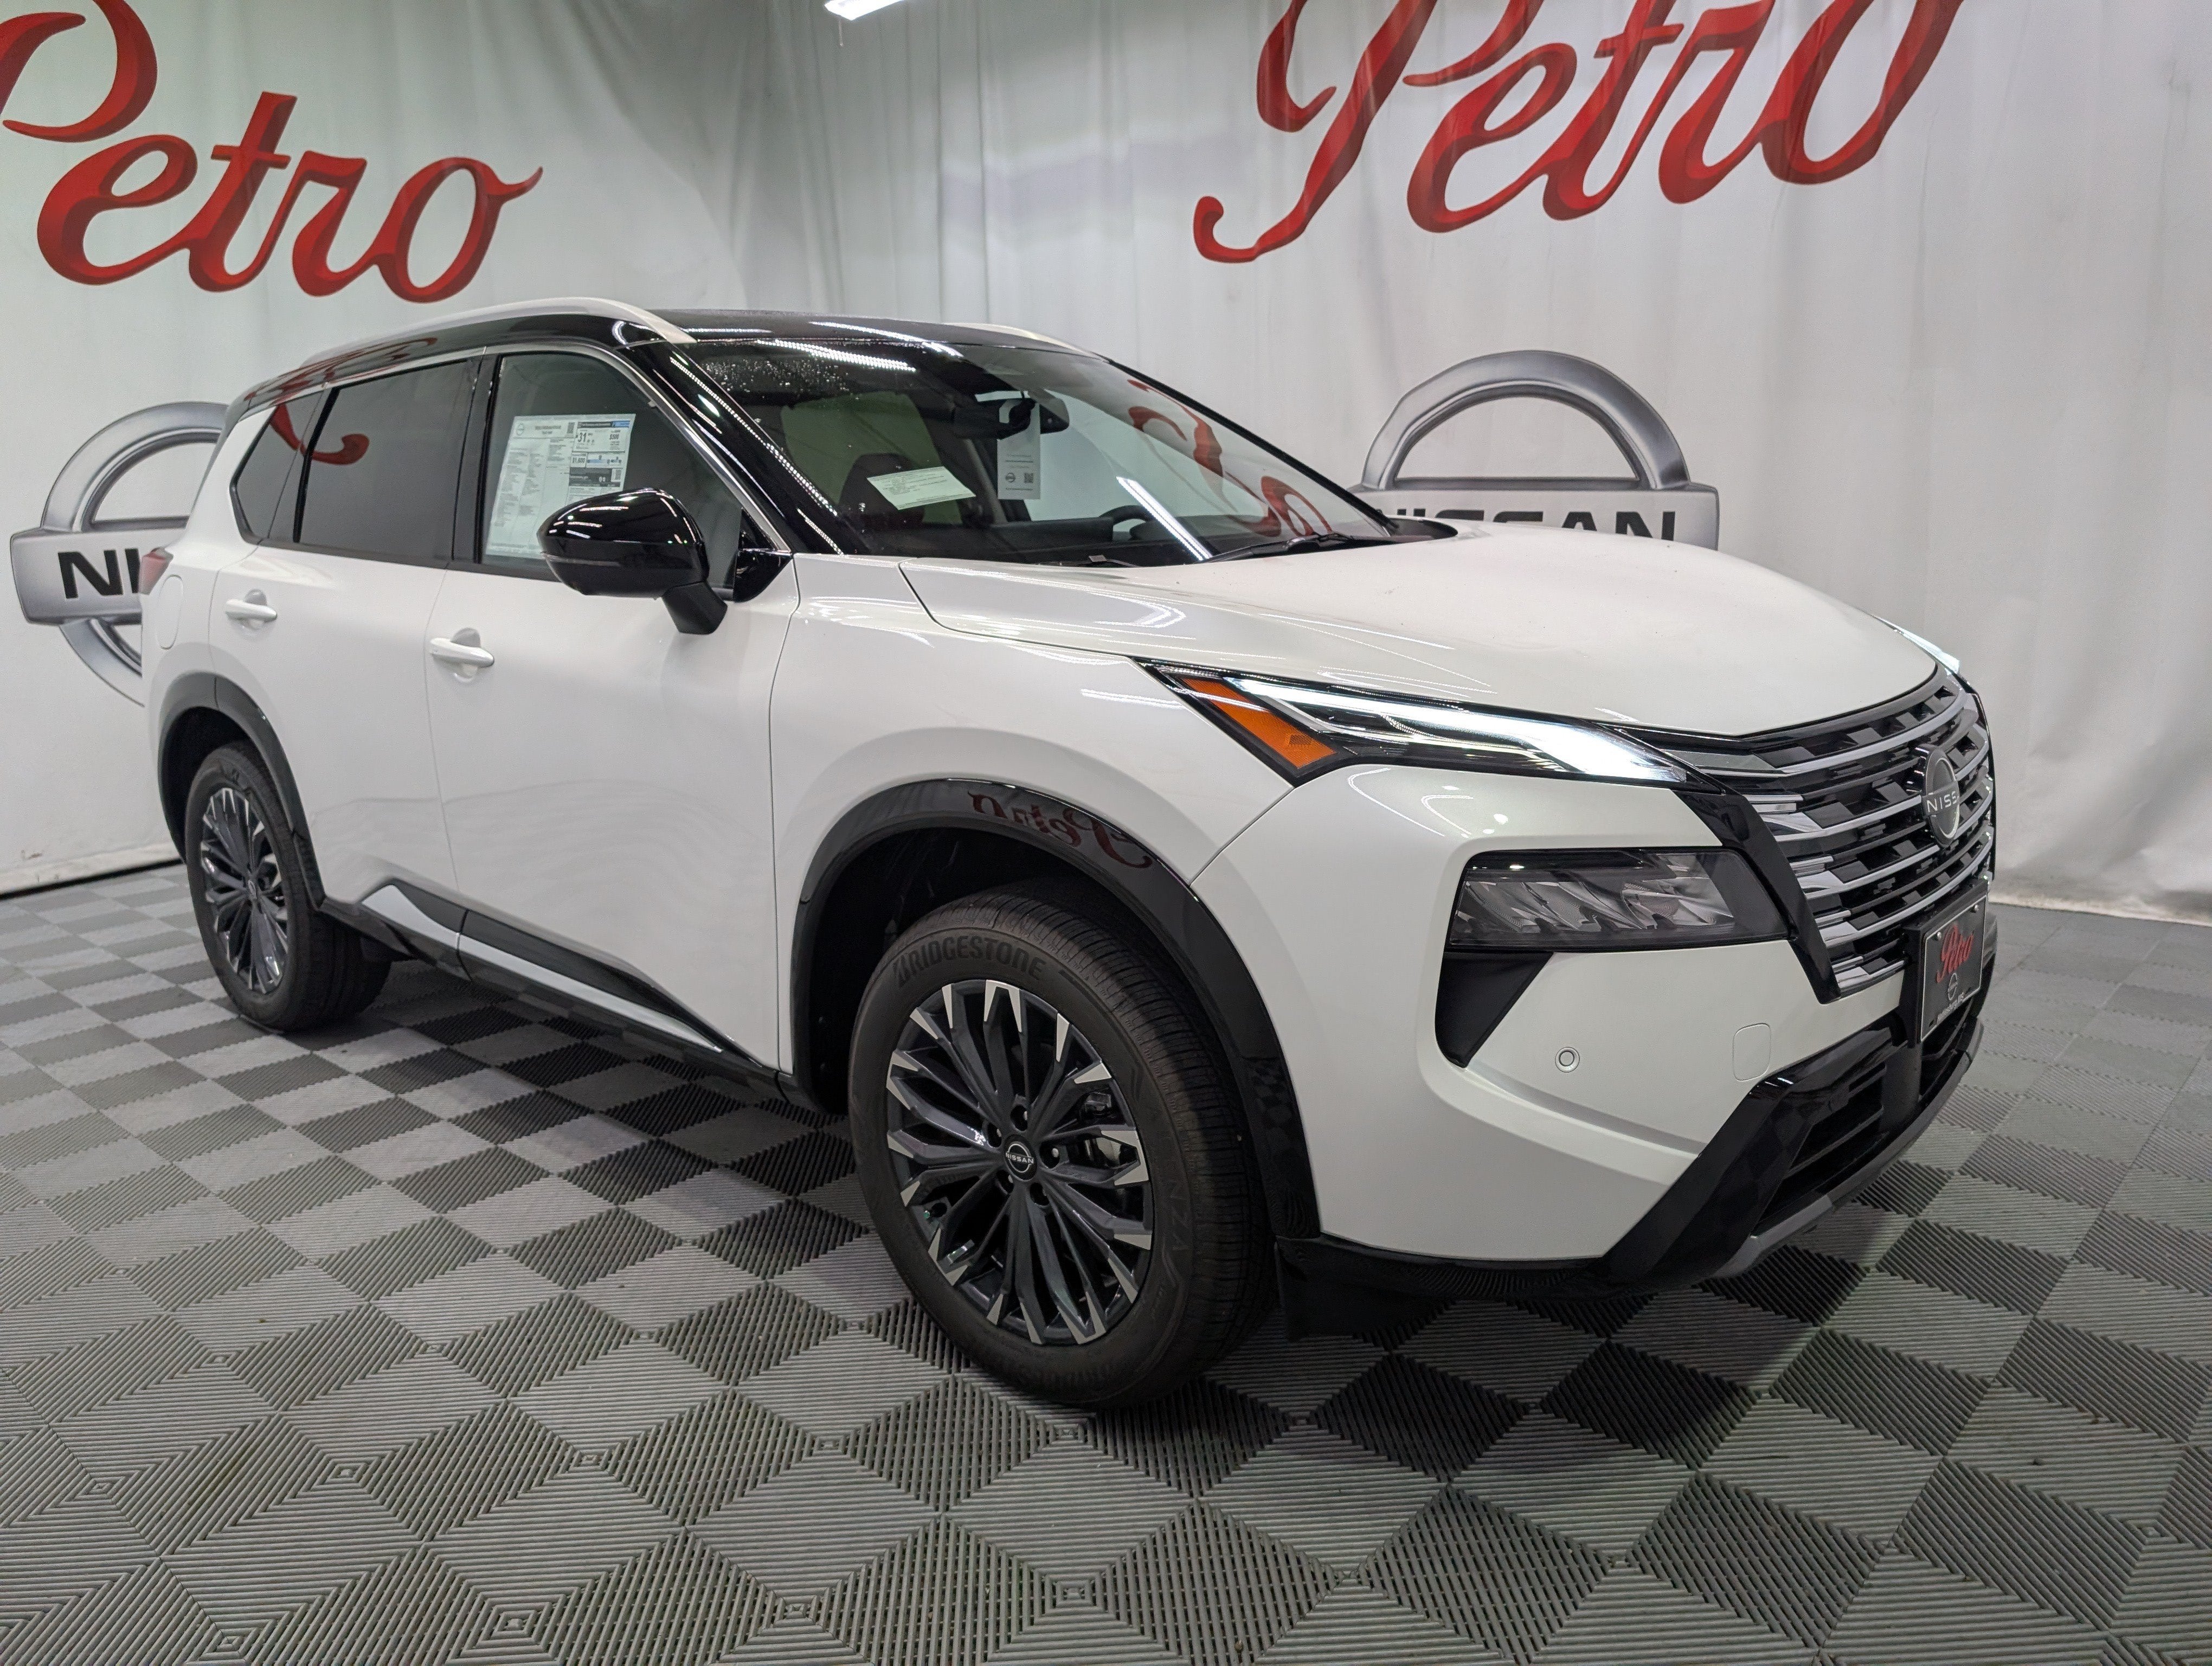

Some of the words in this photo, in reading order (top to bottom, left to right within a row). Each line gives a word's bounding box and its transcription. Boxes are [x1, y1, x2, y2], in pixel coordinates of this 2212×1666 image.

[1926, 790, 1958, 813] NISS
[892, 935, 1047, 988] BRIDGESTONE
[1006, 1152, 1034, 1163] NISSAN
